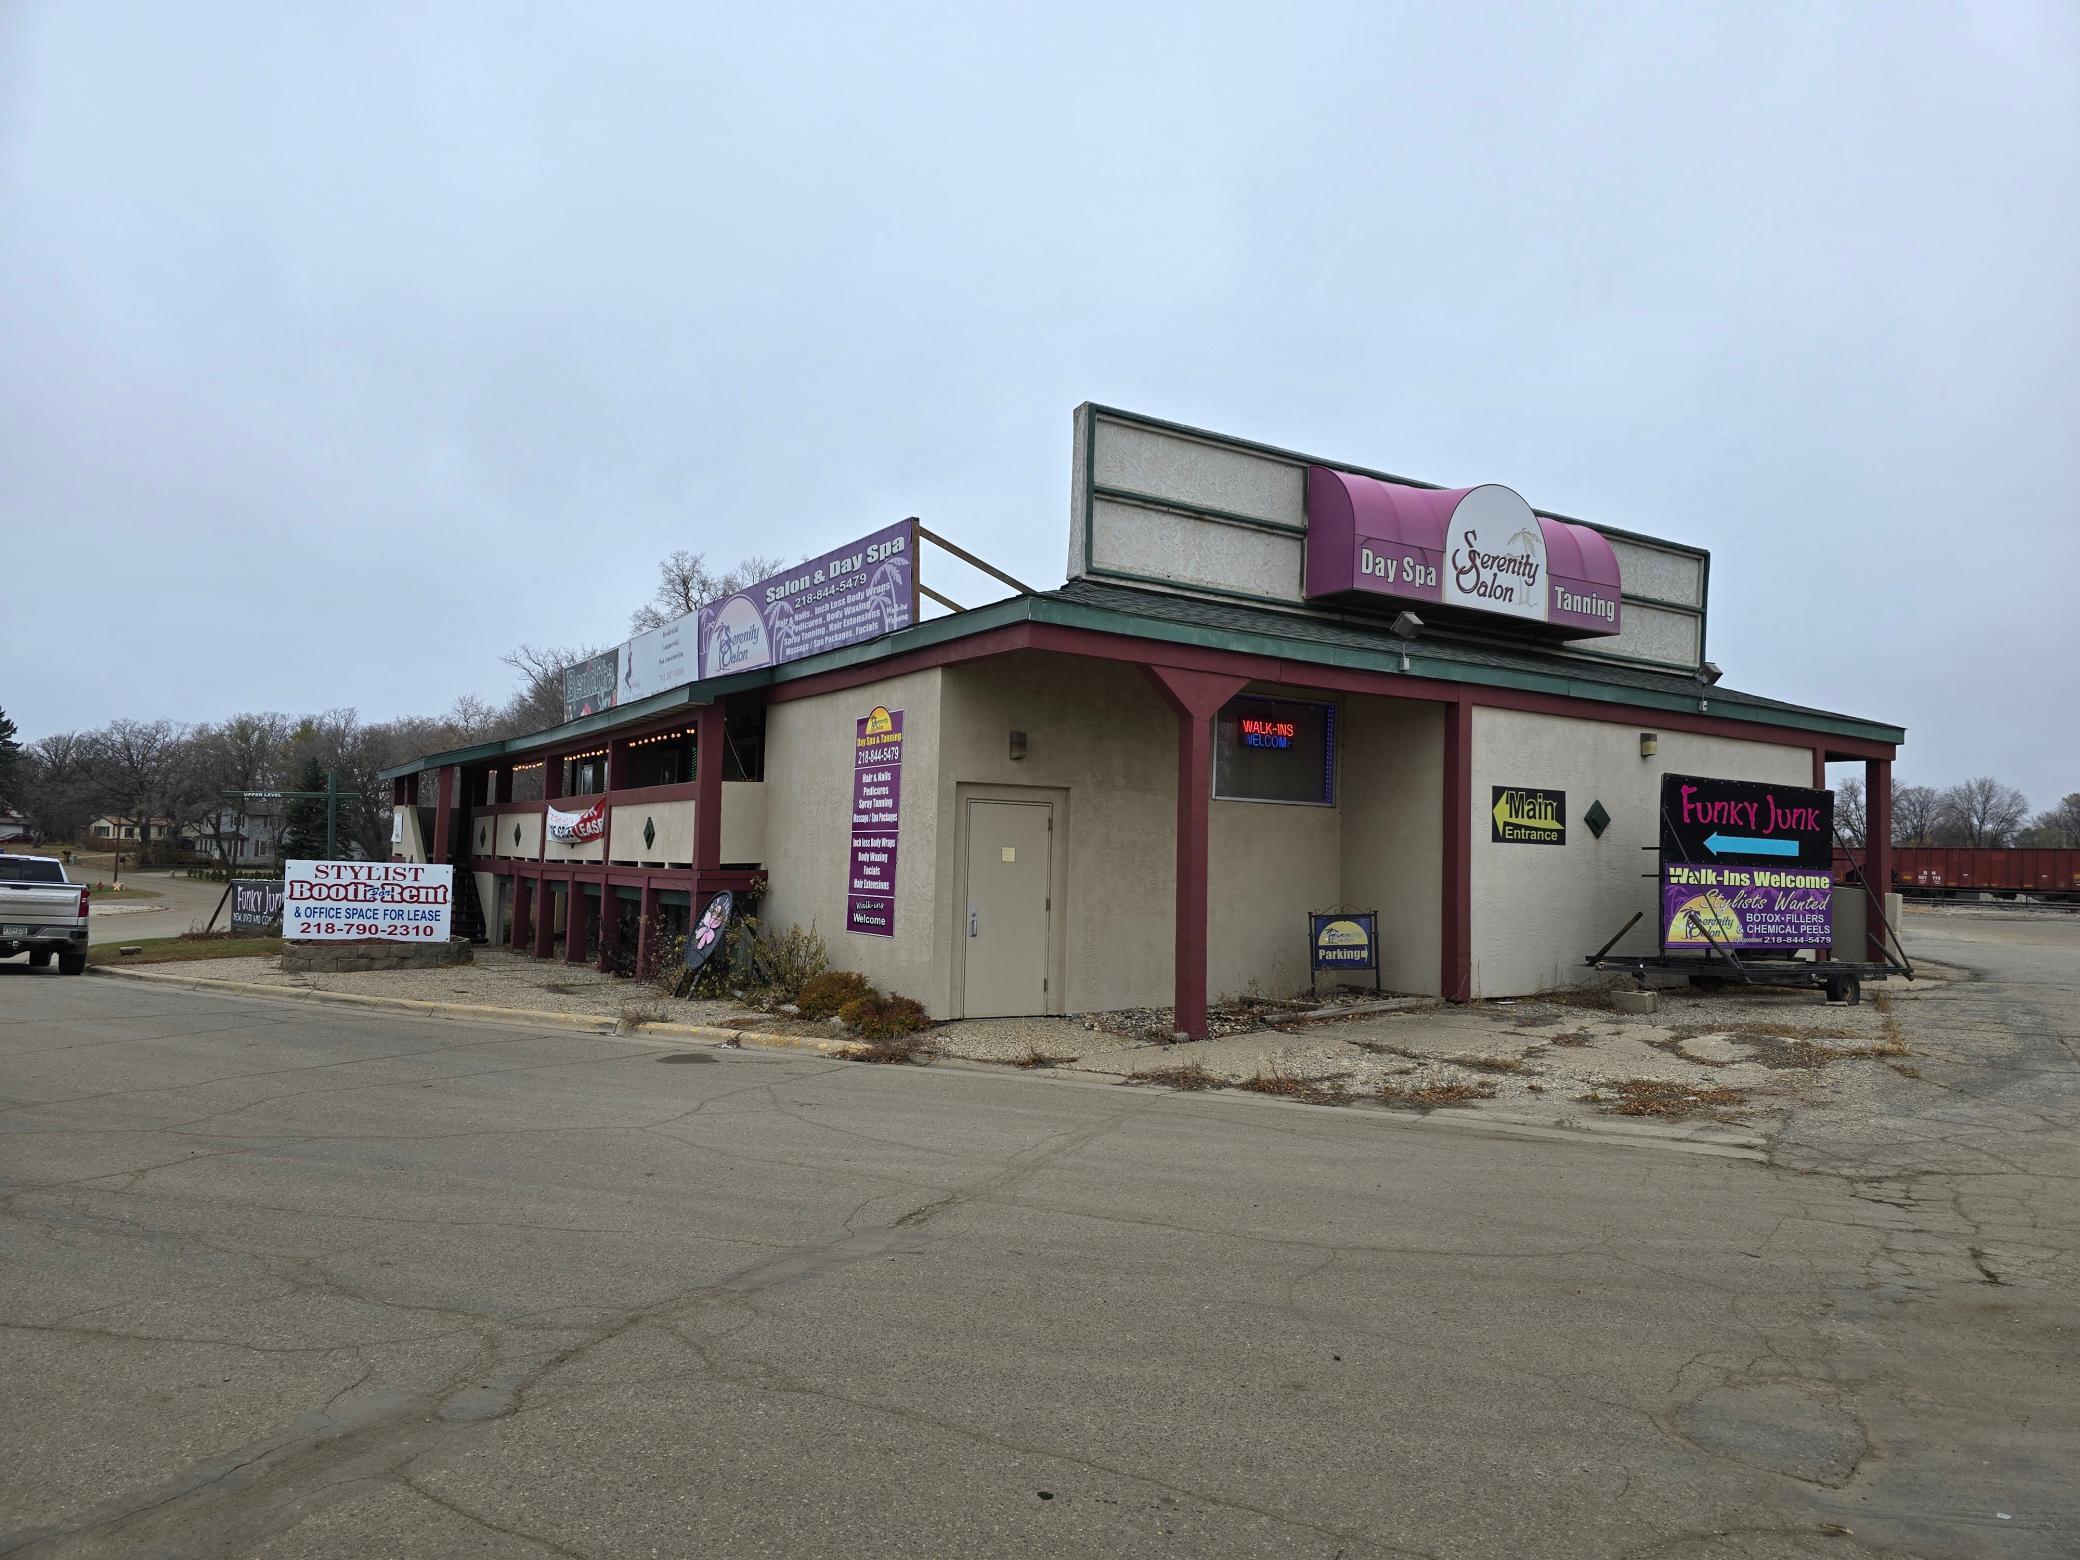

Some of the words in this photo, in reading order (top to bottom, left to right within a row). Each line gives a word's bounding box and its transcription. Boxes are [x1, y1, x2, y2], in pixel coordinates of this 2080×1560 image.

[1452, 530, 1540, 587] Serenity
[765, 575, 810, 603] Salon
[813, 569, 826, 585] &
[829, 553, 863, 579] Day
[866, 536, 905, 564] Spa
[1361, 548, 1398, 583] Day
[1403, 555, 1437, 588] Spa
[1456, 561, 1514, 603] Salon
[795, 573, 867, 608] 218-844-5479
[814, 603, 830, 614] Inch
[830, 597, 846, 609] Loss
[846, 592, 864, 603] Body
[865, 582, 891, 597] Wraps
[1554, 585, 1615, 623] Tanning
[826, 610, 844, 621] Body
[843, 610, 881, 627] Extensions
[856, 622, 879, 636] Facials
[722, 624, 760, 652] Serenity
[722, 640, 749, 667] Salon
[1242, 720, 1294, 737] WALK-INS
[866, 736, 876, 746] Spa
[881, 733, 901, 743] Tanning
[1245, 733, 1294, 749] WELCOM
[858, 746, 899, 764] 218-844-5479
[862, 773, 873, 783] Hair
[878, 771, 892, 781] Nails
[863, 786, 889, 796] Pedicures
[859, 799, 872, 809] Spray
[873, 798, 893, 808] Tanning
[1508, 791, 1557, 821] Main
[1505, 826, 1558, 841] Entrance
[870, 837, 881, 848] Body
[881, 837, 895, 848] Wraps
[858, 851, 869, 862] Body
[870, 852, 888, 863] Waxing
[314, 864, 424, 882] STYLIST
[863, 865, 880, 875] Facials
[1669, 867, 1750, 887] Walk-Ins
[1754, 871, 1831, 889] Welcome
[290, 880, 376, 902] Booth
[367, 887, 391, 901] For
[381, 883, 448, 904] Rent
[854, 878, 864, 889] Hair
[863, 879, 889, 890] Extensions
[1700, 888, 1767, 911] Stylists
[1775, 891, 1831, 911] Wanted
[294, 906, 301, 918] &
[304, 906, 342, 919] OFFICE
[344, 907, 379, 920] SPACE
[383, 908, 404, 921] FOR
[407, 909, 441, 922] LEASE
[853, 913, 886, 925] Welcome
[300, 922, 434, 937] 218-790-2310
[1747, 924, 1798, 934] CHEMICAL
[1800, 925, 1830, 934] PEELS
[1318, 948, 1361, 960] Parking
